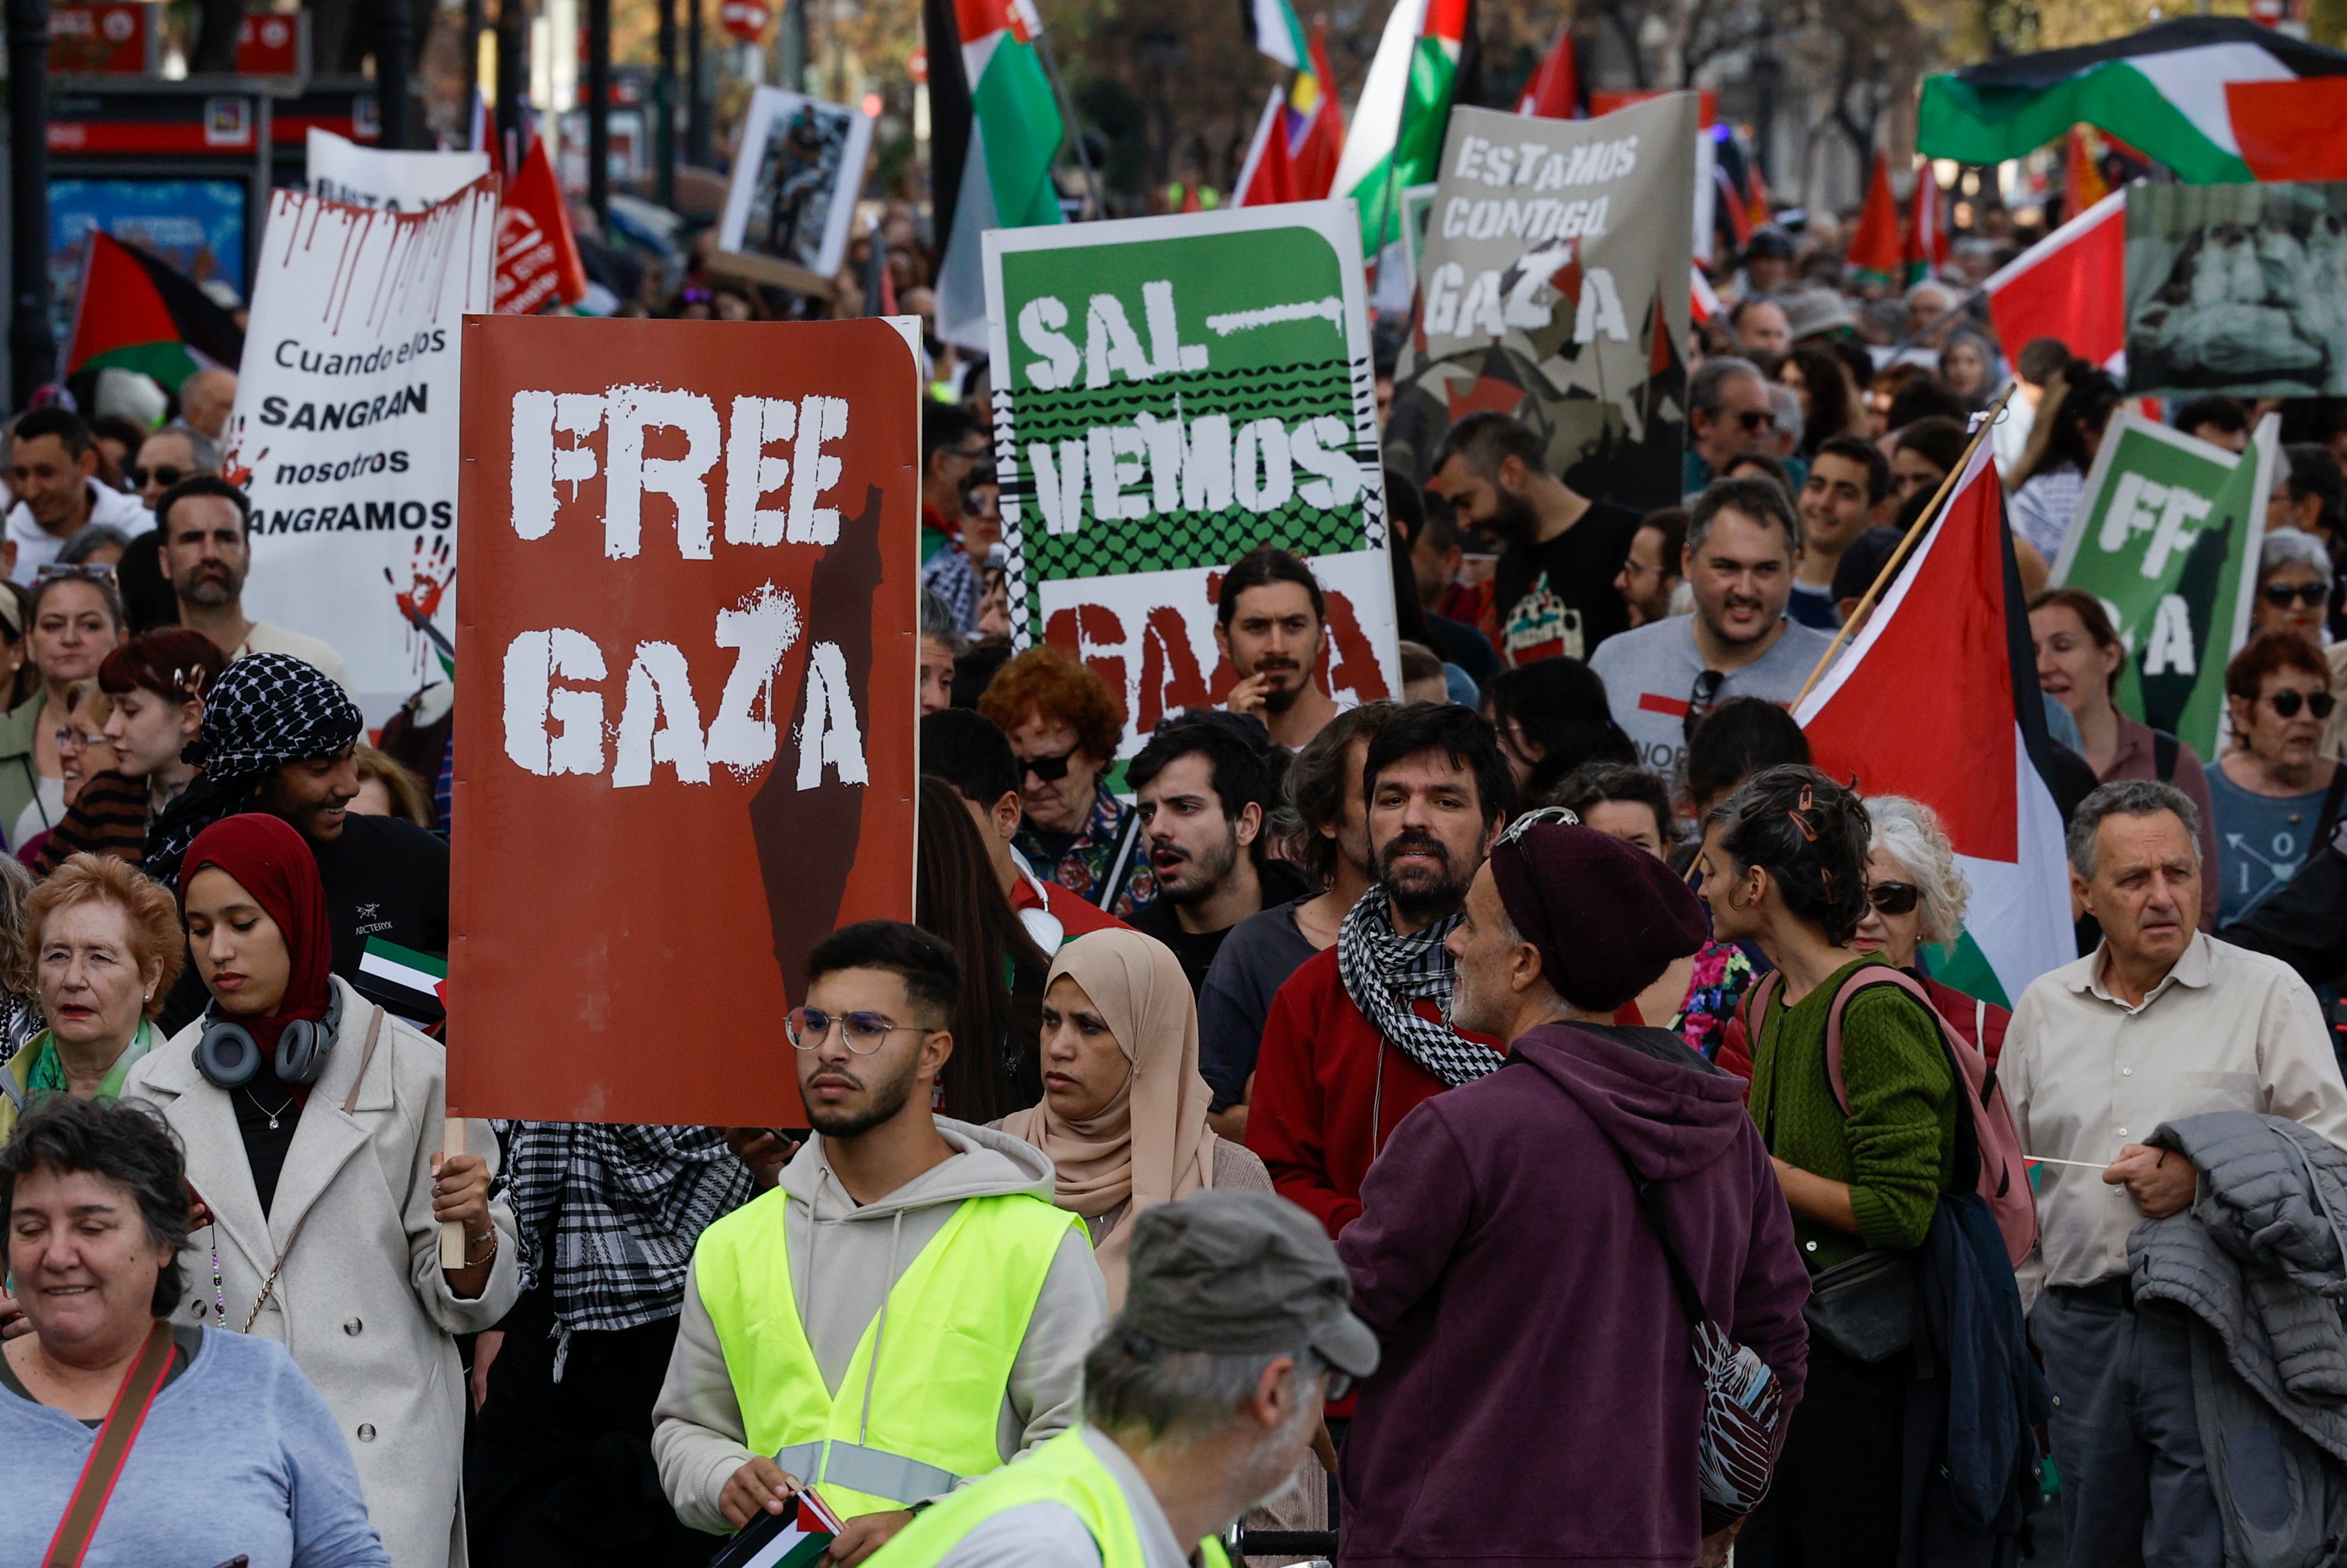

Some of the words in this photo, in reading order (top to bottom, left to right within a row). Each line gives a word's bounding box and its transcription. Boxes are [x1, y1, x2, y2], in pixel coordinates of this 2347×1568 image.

[1455, 134, 1639, 191] ESTAMOS
[1423, 242, 1630, 343] GAZA
[275, 338, 393, 376] Cuando
[259, 383, 428, 431] SANGRAN
[275, 450, 410, 485] nosotros
[510, 381, 848, 561] FREE
[1027, 395, 1364, 534] VEMOS
[248, 501, 452, 535] ANGRAMOS
[1044, 555, 1390, 735] GAA
[502, 578, 869, 792] GAZA
